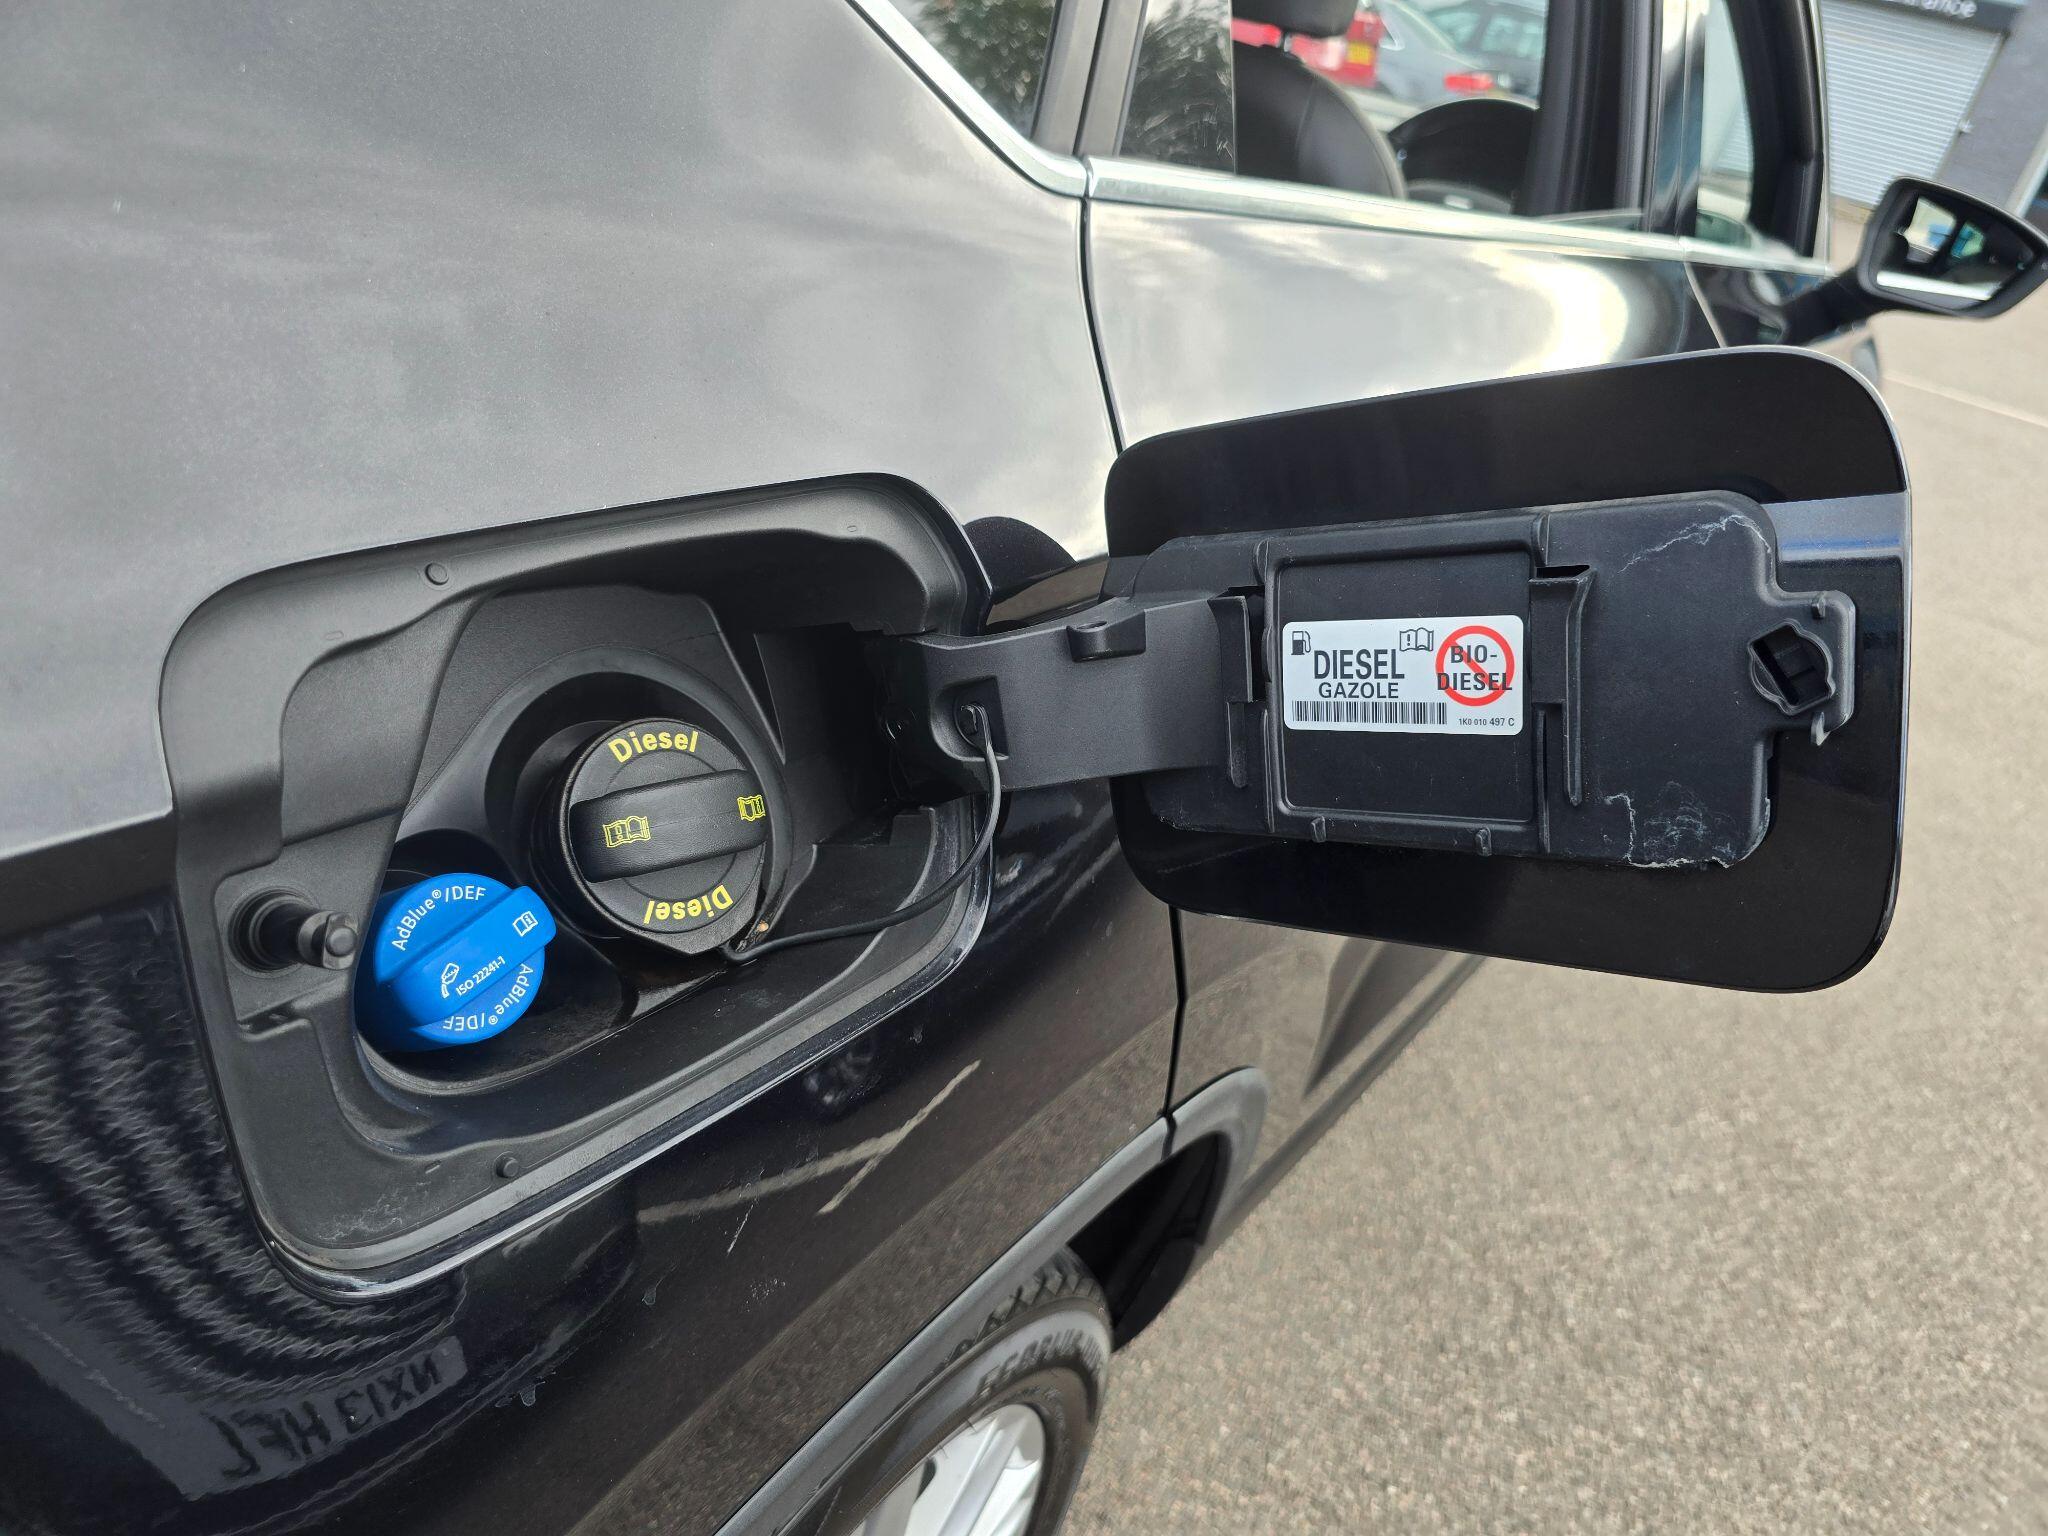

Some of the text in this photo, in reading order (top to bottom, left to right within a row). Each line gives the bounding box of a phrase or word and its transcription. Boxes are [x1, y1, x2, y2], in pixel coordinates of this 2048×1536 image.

[1313, 649, 1405, 680] DIESEL
[1450, 644, 1498, 664] BIO-
[1318, 681, 1399, 699] GAZOLE
[1437, 672, 1513, 691] DIESEL
[1473, 718, 1487, 726] 010
[1489, 717, 1505, 727] 497
[1507, 717, 1515, 727] C
[608, 730, 699, 763] Diesel
[643, 884, 733, 924] Diesel
[455, 956, 506, 996] ISO 22241-1
